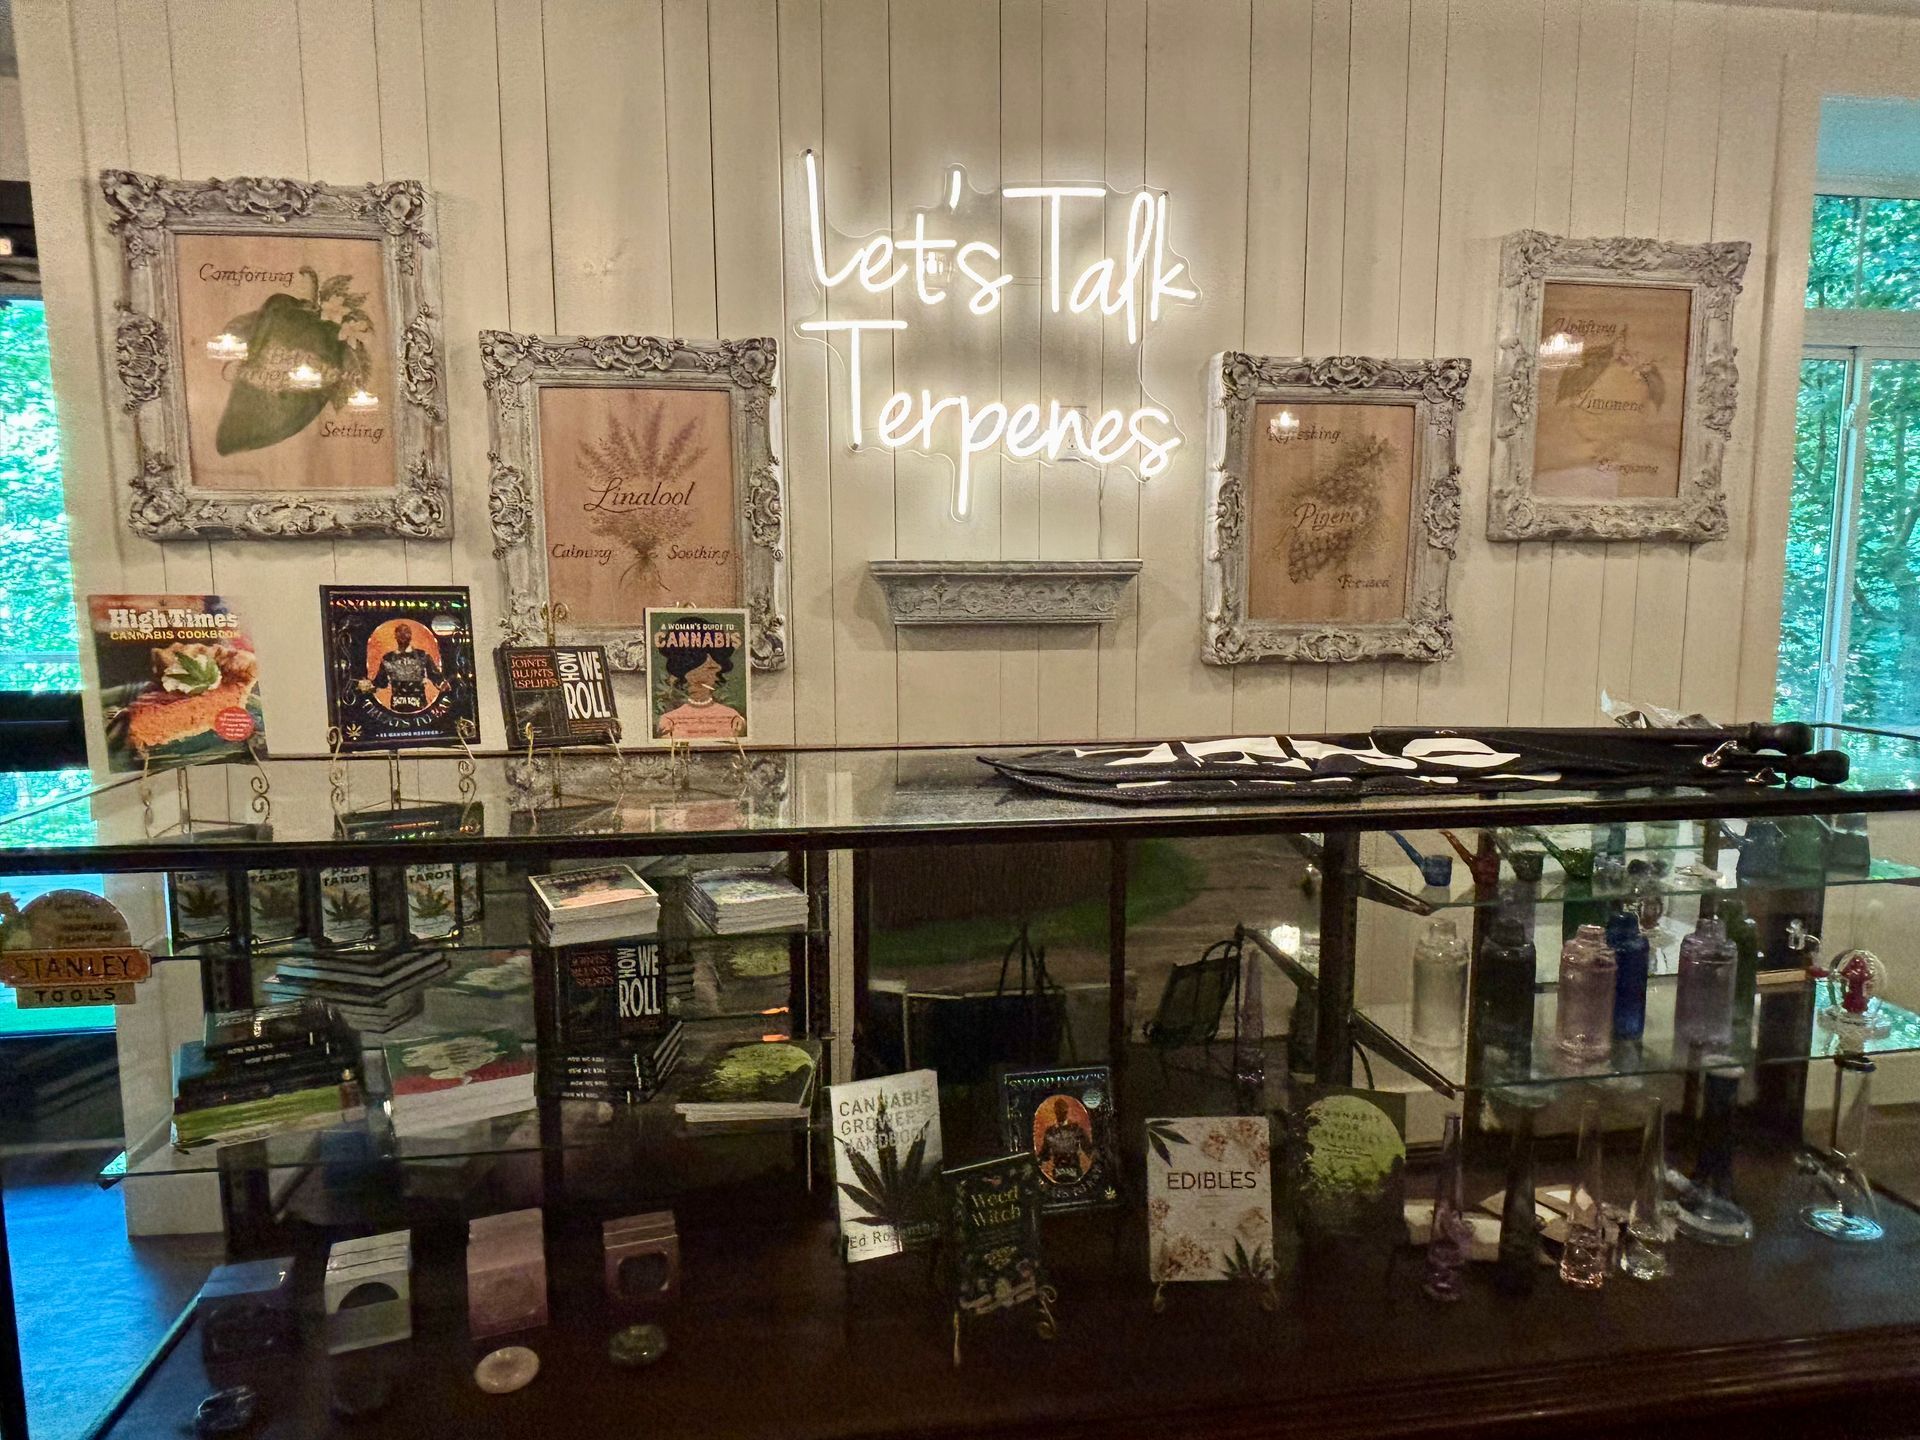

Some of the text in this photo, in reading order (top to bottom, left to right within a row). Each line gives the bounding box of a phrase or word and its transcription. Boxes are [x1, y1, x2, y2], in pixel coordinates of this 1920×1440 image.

[805, 153, 1197, 344] Let's Talk
[800, 320, 1183, 516] Terpenes
[319, 421, 385, 443] Settling
[583, 477, 696, 513] Linalool
[552, 543, 613, 565] Calming
[668, 544, 730, 565] Soothing
[110, 629, 241, 640] CANNABIS COOKBOOK
[668, 622, 701, 631] WOMAN'S
[726, 623, 735, 631] TO
[654, 631, 742, 649] CANNABIS
[511, 658, 548, 669] JOINTS
[557, 652, 580, 681] HOW
[577, 651, 603, 681] WE
[563, 681, 611, 720] ROLL
[409, 870, 453, 883] TAROT
[15, 955, 132, 979] STANLEY
[617, 947, 637, 979] HOW
[638, 944, 659, 977] WE
[34, 987, 116, 1003] TOOLS
[618, 977, 661, 1018] ROLL
[1167, 1170, 1257, 1190] EDIBLES
[850, 1234, 867, 1249] Ed
